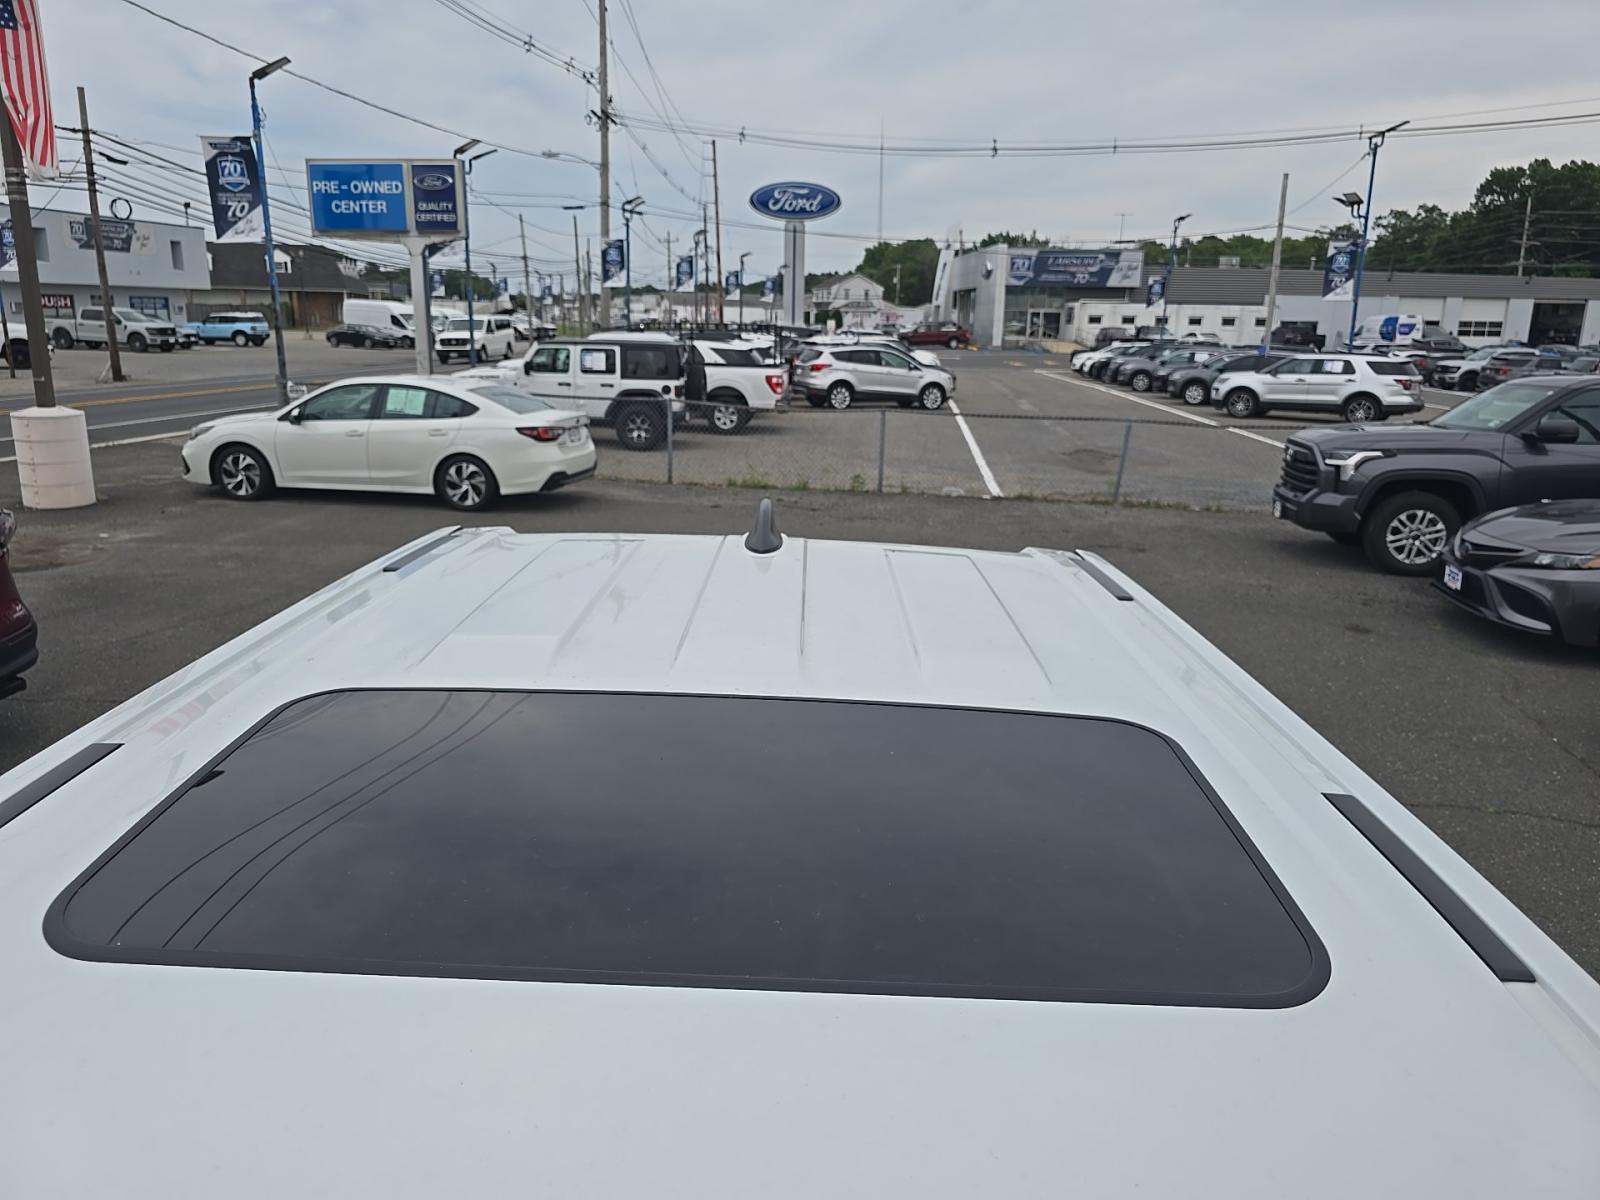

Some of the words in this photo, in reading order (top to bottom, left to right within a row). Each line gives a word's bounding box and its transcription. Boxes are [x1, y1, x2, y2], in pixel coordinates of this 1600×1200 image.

[220, 161, 241, 178] 70
[331, 200, 388, 214] CENTER
[417, 201, 454, 211] QUALITY
[767, 188, 823, 213] Ford
[227, 201, 250, 218] 70
[416, 212, 457, 222] CERTIFIED
